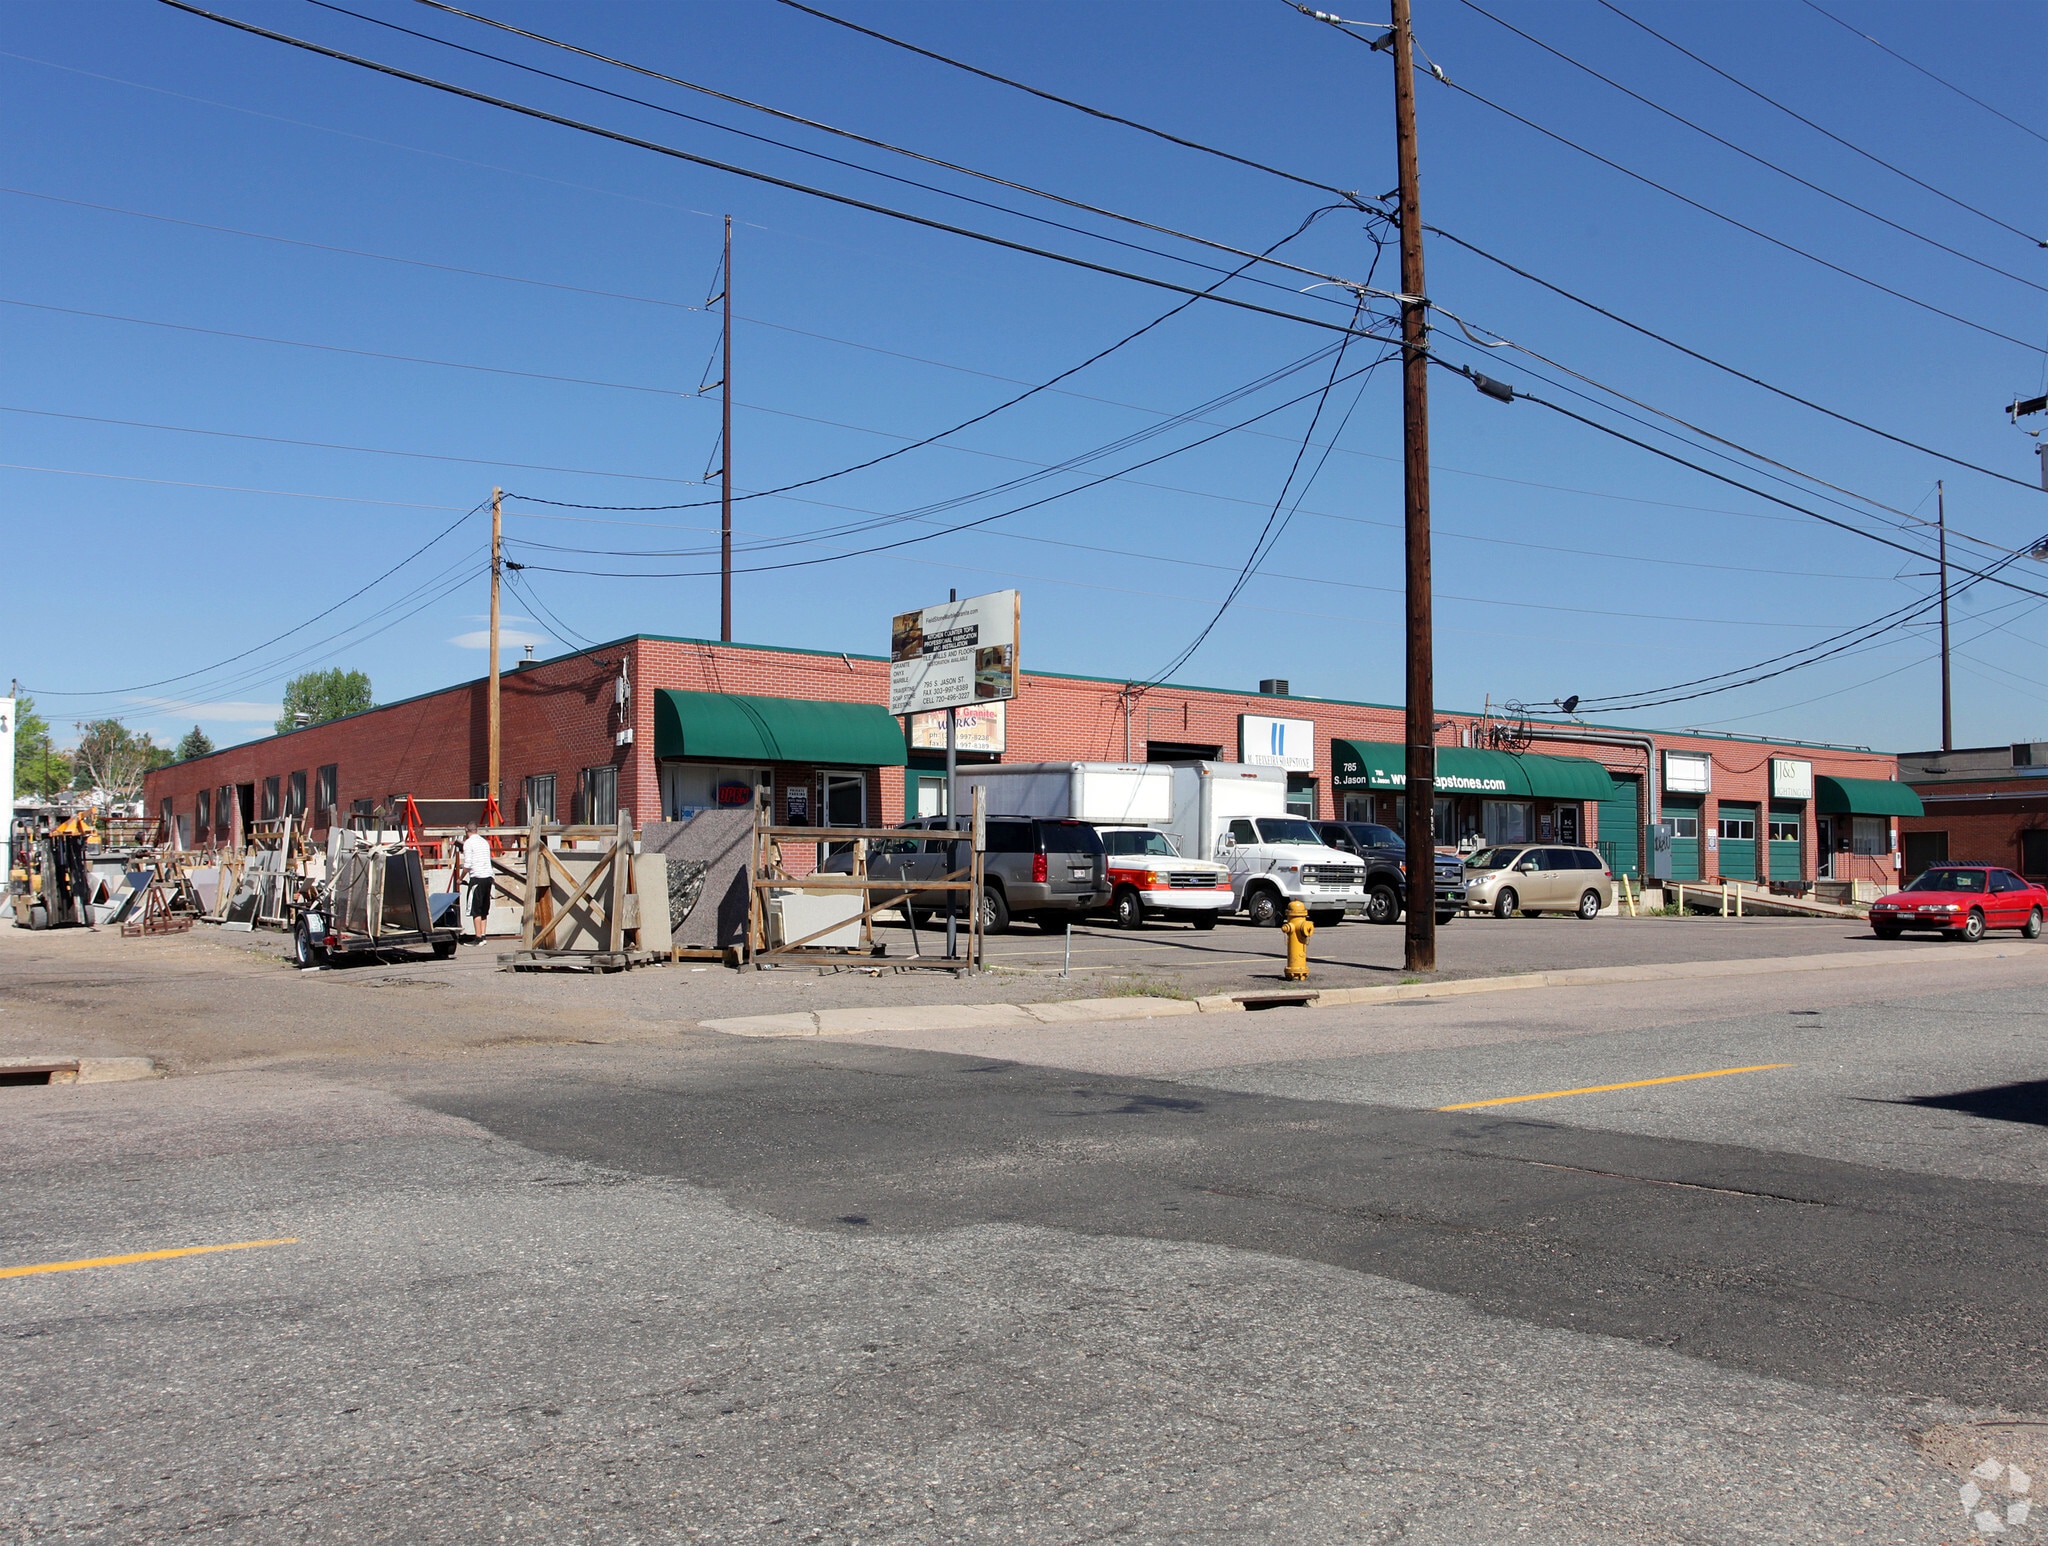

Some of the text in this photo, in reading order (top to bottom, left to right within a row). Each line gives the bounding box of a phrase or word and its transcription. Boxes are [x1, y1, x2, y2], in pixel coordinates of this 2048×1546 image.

[944, 629, 962, 637] COUNTER
[924, 632, 977, 647] PROFESSIONAL FABRICATION
[942, 640, 968, 650] INSTALLATION
[958, 647, 976, 656] FLOORS
[951, 656, 968, 664] AVAILABLE
[894, 662, 910, 670] GRANITE
[940, 678, 956, 686] JASON
[964, 708, 995, 718] Granite
[938, 716, 977, 729] WRKS
[1279, 756, 1310, 768] SOAPSTONE
[1343, 762, 1357, 772] 785
[1334, 776, 1366, 784] S. Jason
[719, 787, 750, 804] OPEN
